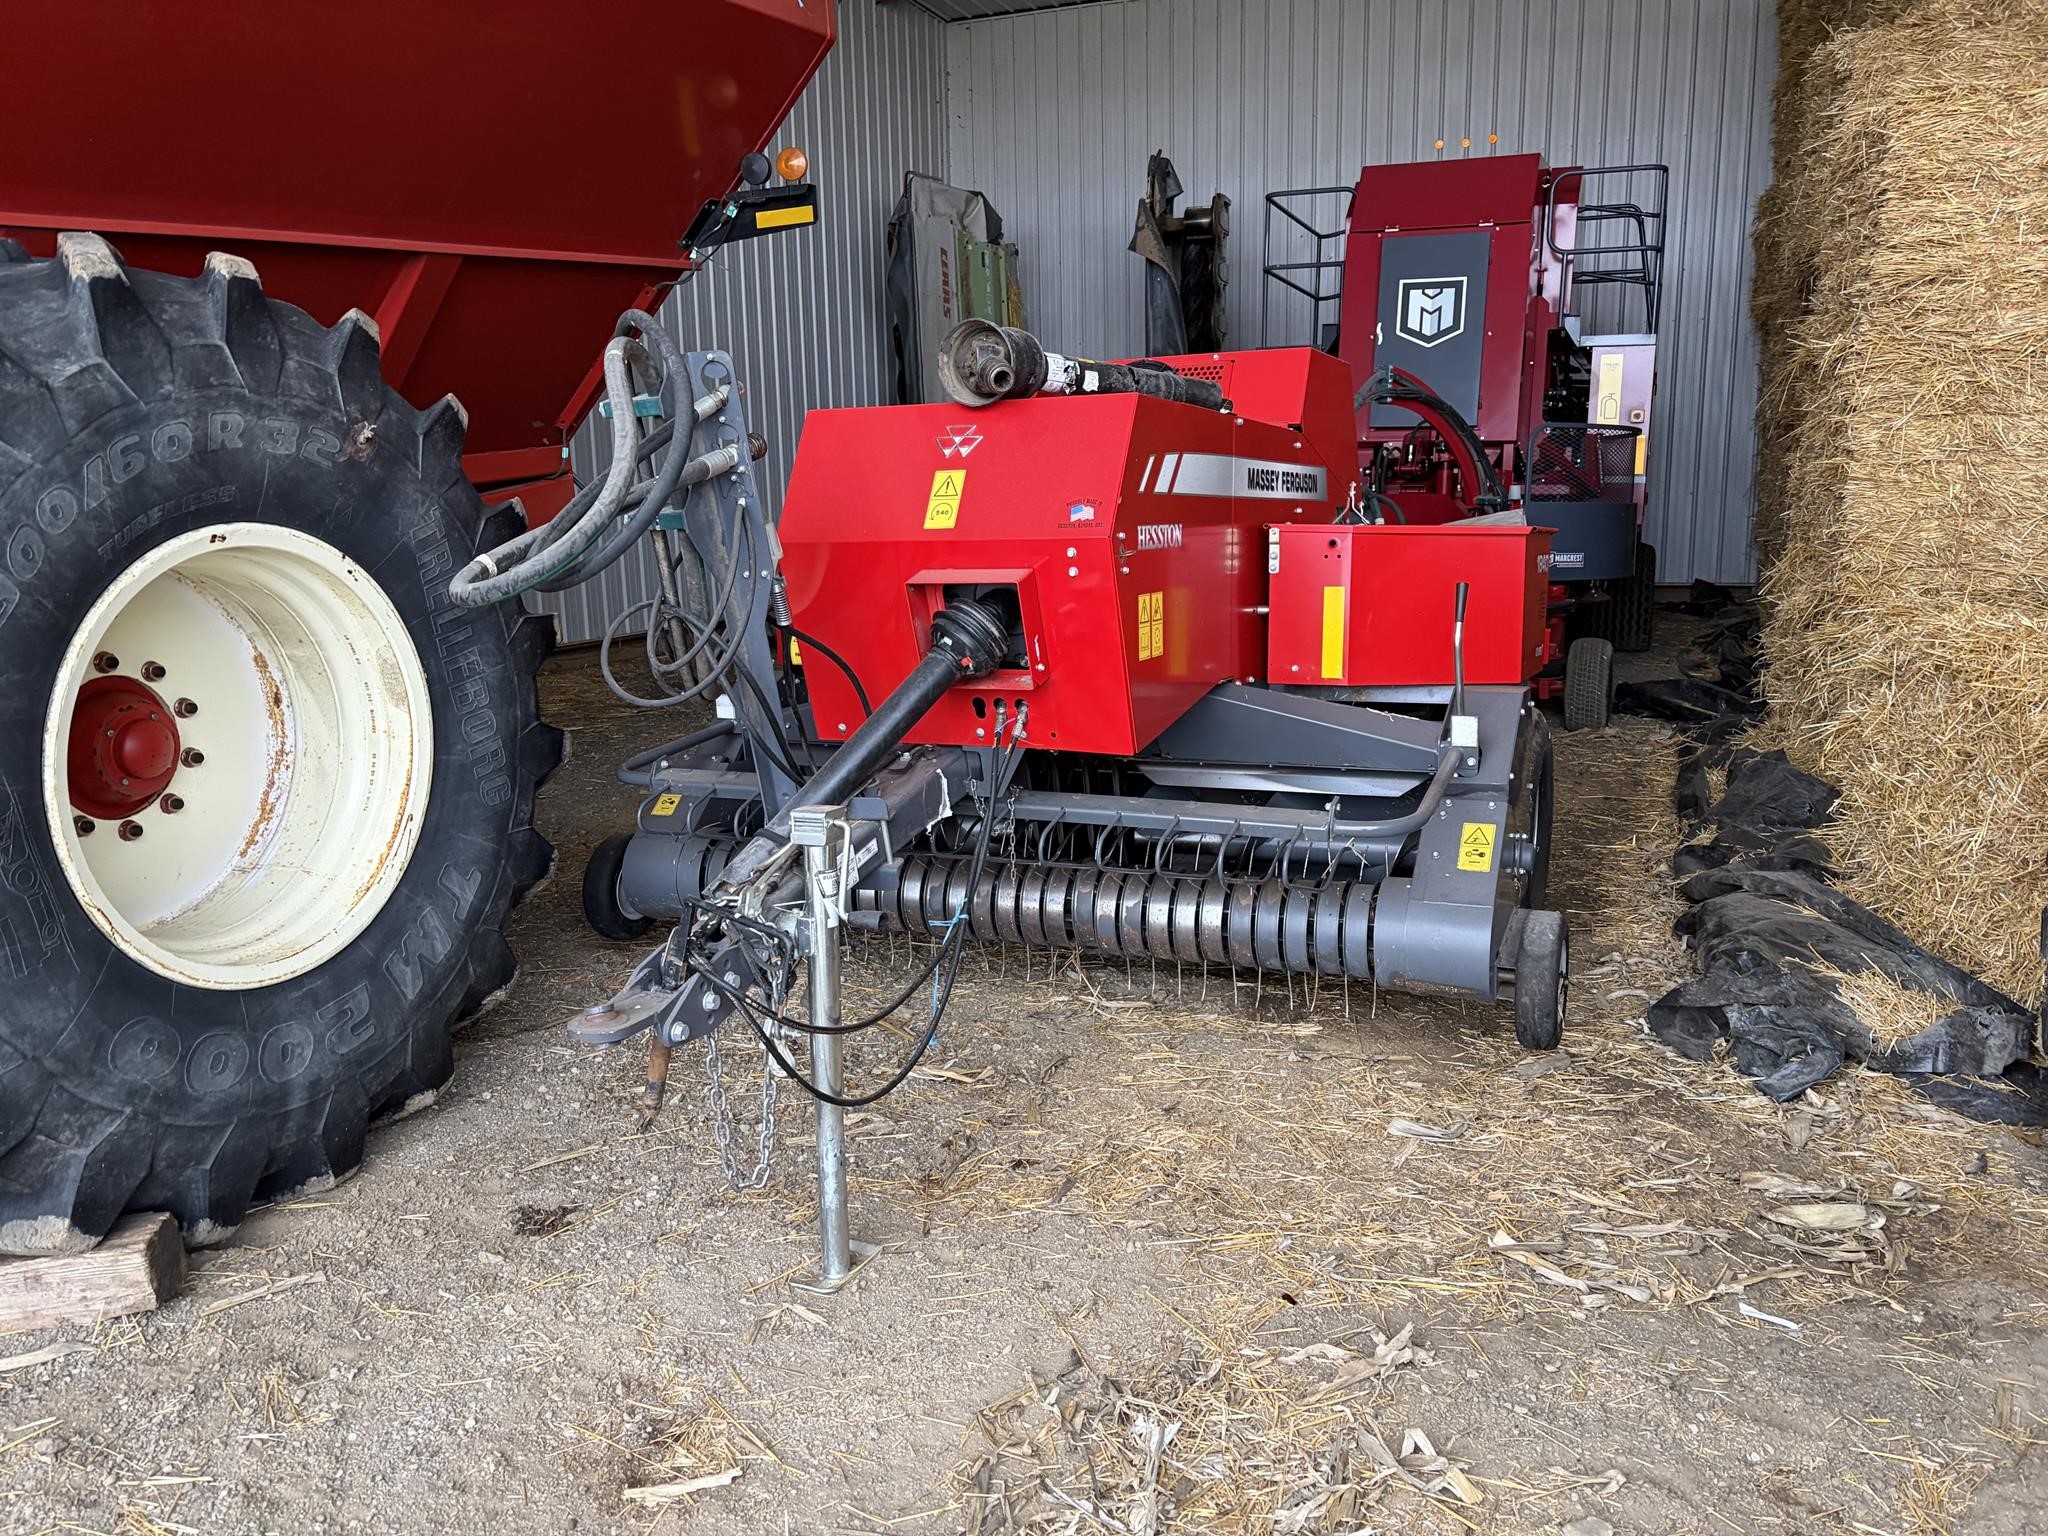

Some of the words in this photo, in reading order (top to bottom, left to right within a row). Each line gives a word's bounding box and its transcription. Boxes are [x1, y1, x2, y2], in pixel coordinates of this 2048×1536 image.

[1247, 467, 1280, 491] MASSEY
[1281, 471, 1318, 494] FERGUSON
[1137, 524, 1183, 550] HESSTON
[1554, 554, 1583, 562] MARCREST
[410, 505, 512, 807] TRELLEBORG
